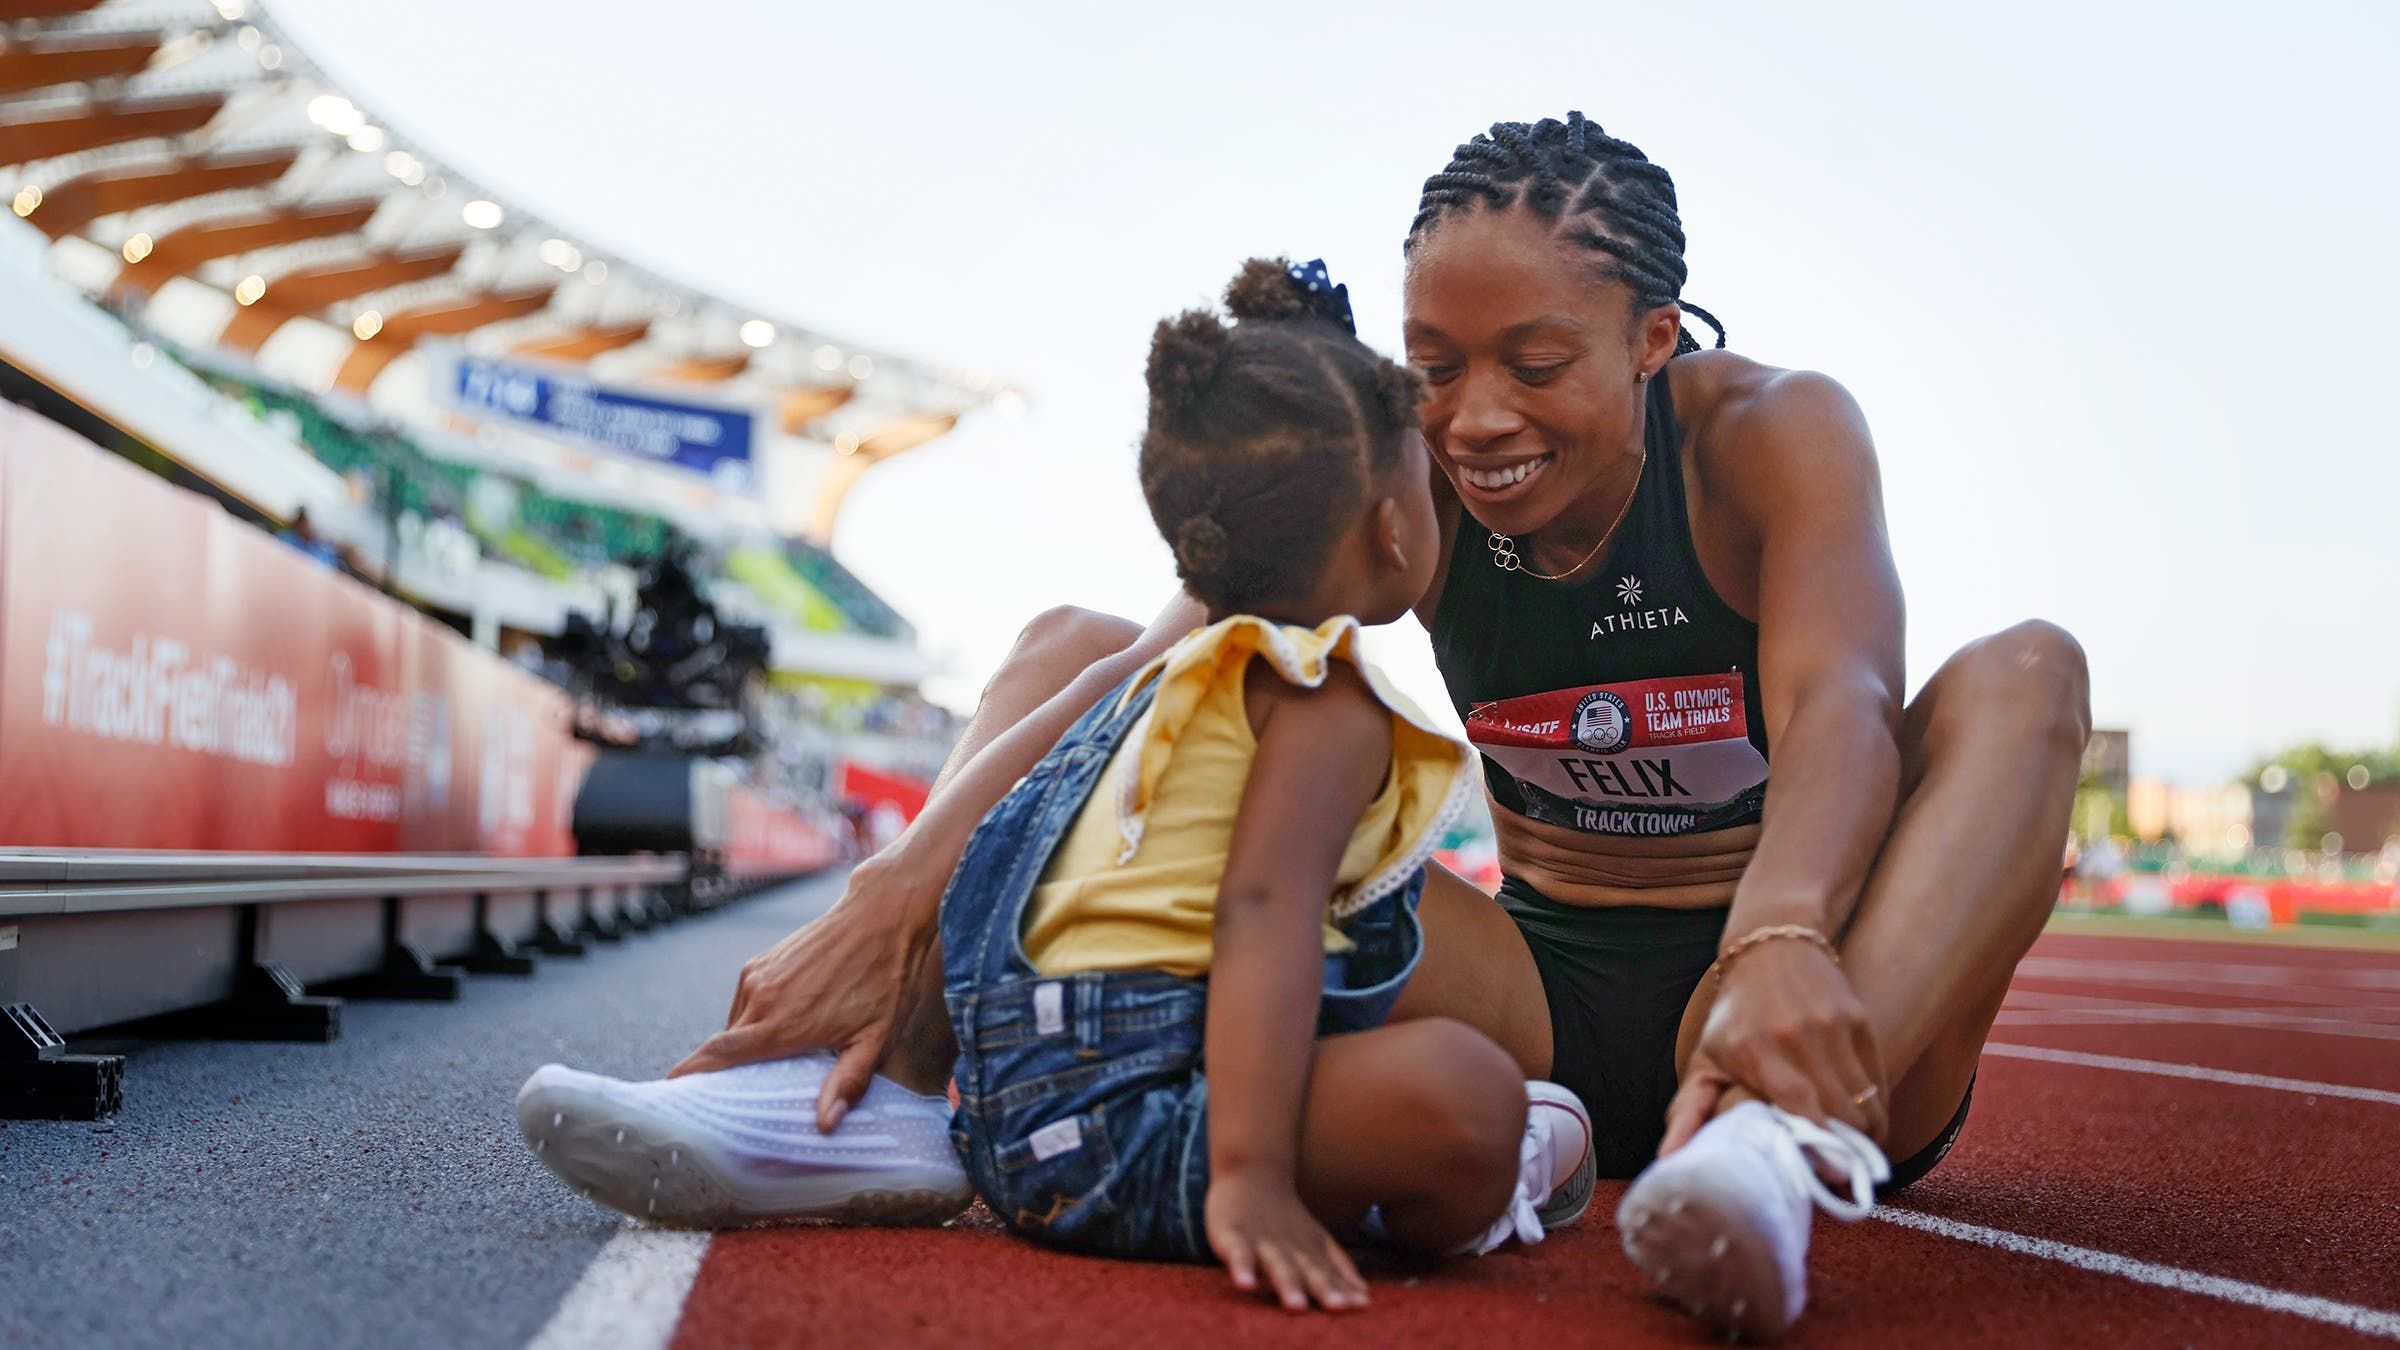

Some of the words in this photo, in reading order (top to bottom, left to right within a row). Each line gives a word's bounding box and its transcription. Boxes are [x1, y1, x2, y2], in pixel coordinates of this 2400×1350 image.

[1590, 606, 1689, 640] ATHLETA
[1575, 693, 1597, 714] UNITED
[1599, 691, 1625, 709] STATES
[1645, 691, 1671, 712] U.S.
[1645, 711, 1683, 732] TEAM
[1685, 707, 1731, 727] TRIALS
[1647, 730, 1676, 741] TRACK
[1676, 729, 1683, 738] &
[1684, 726, 1706, 736] FIELD
[1557, 758, 1692, 797] FELIX
[1574, 805, 1696, 835] TRACKTOWN
